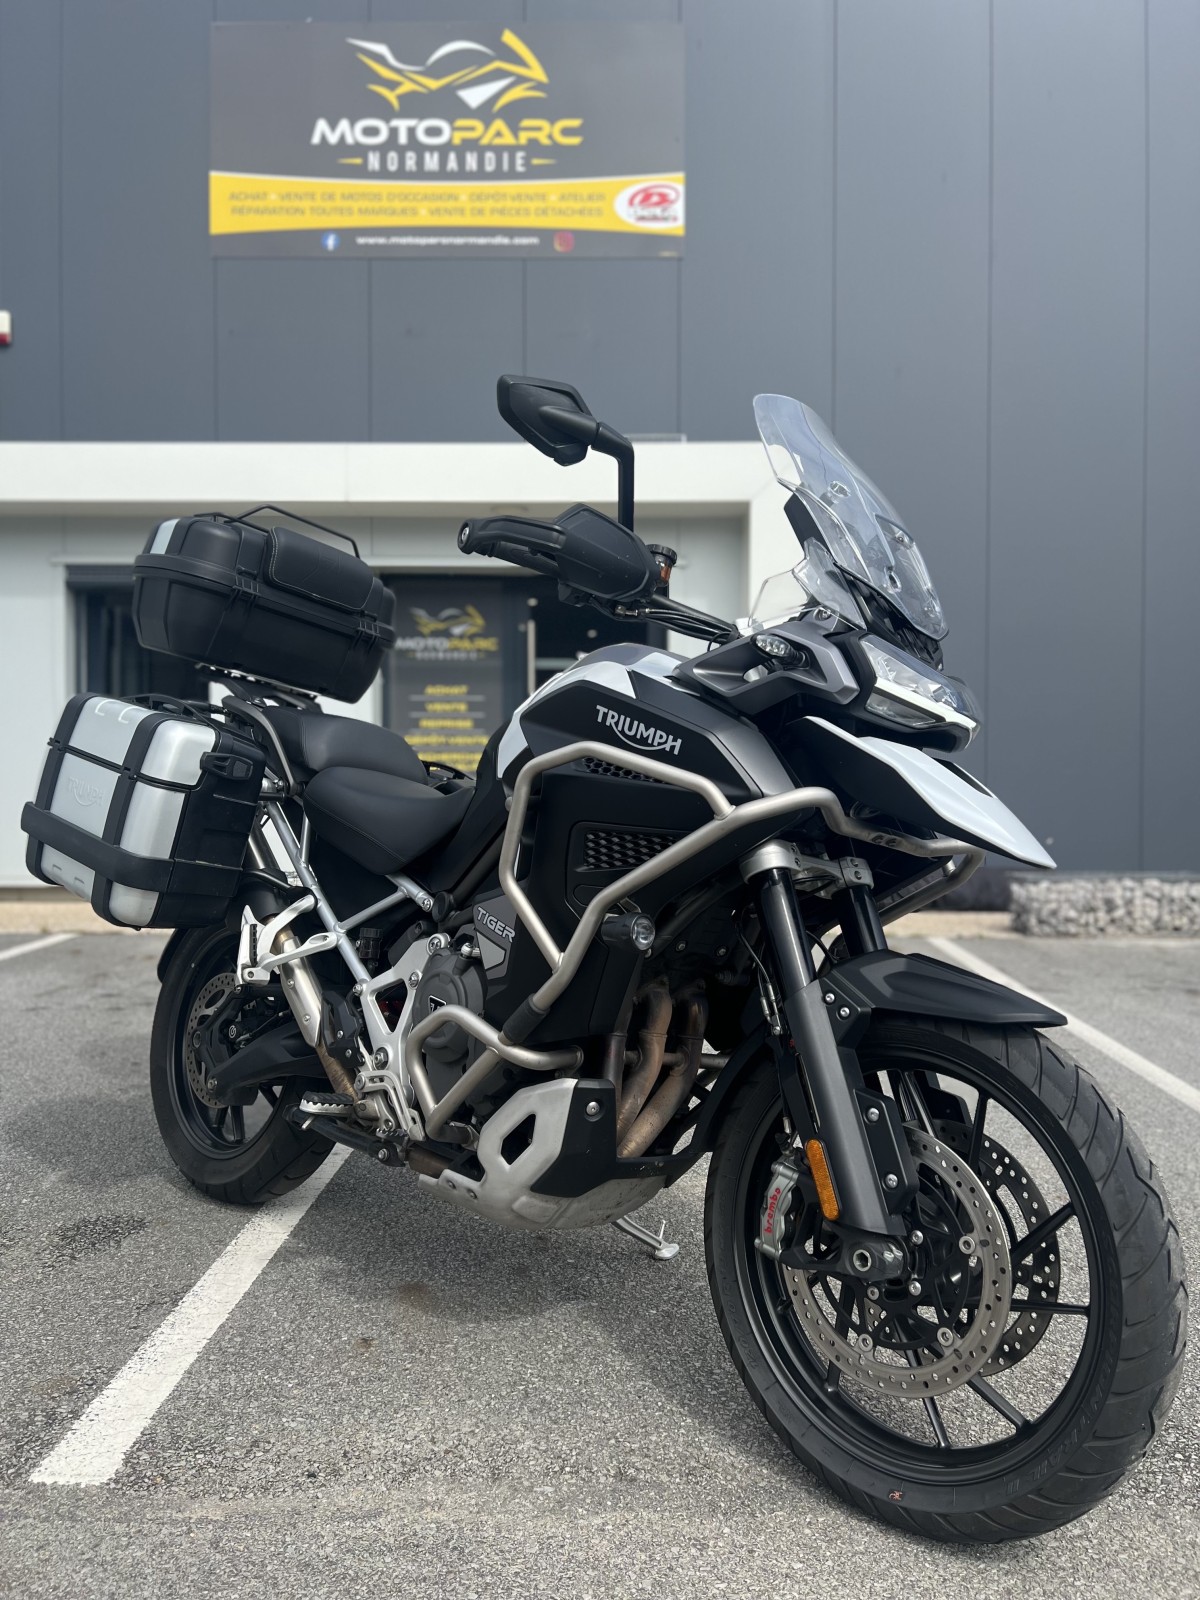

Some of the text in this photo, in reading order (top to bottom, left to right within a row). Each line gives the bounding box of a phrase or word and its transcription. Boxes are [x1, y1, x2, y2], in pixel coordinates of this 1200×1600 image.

[310, 118, 583, 145] MOTOPARC
[367, 151, 527, 172] NORMANDIE
[229, 191, 268, 202] ACHAT
[277, 191, 317, 202] VENTE
[320, 191, 336, 202] DE
[339, 191, 383, 202] MOTOS
[558, 192, 606, 203] ATELIER
[309, 206, 354, 217] TOUTES
[357, 206, 417, 217] MARQUES
[428, 206, 466, 217] VENTE
[469, 206, 485, 217] DE
[596, 705, 682, 755] TRIUMPH
[477, 907, 516, 943] TIGER
[764, 1187, 781, 1235] brembo
